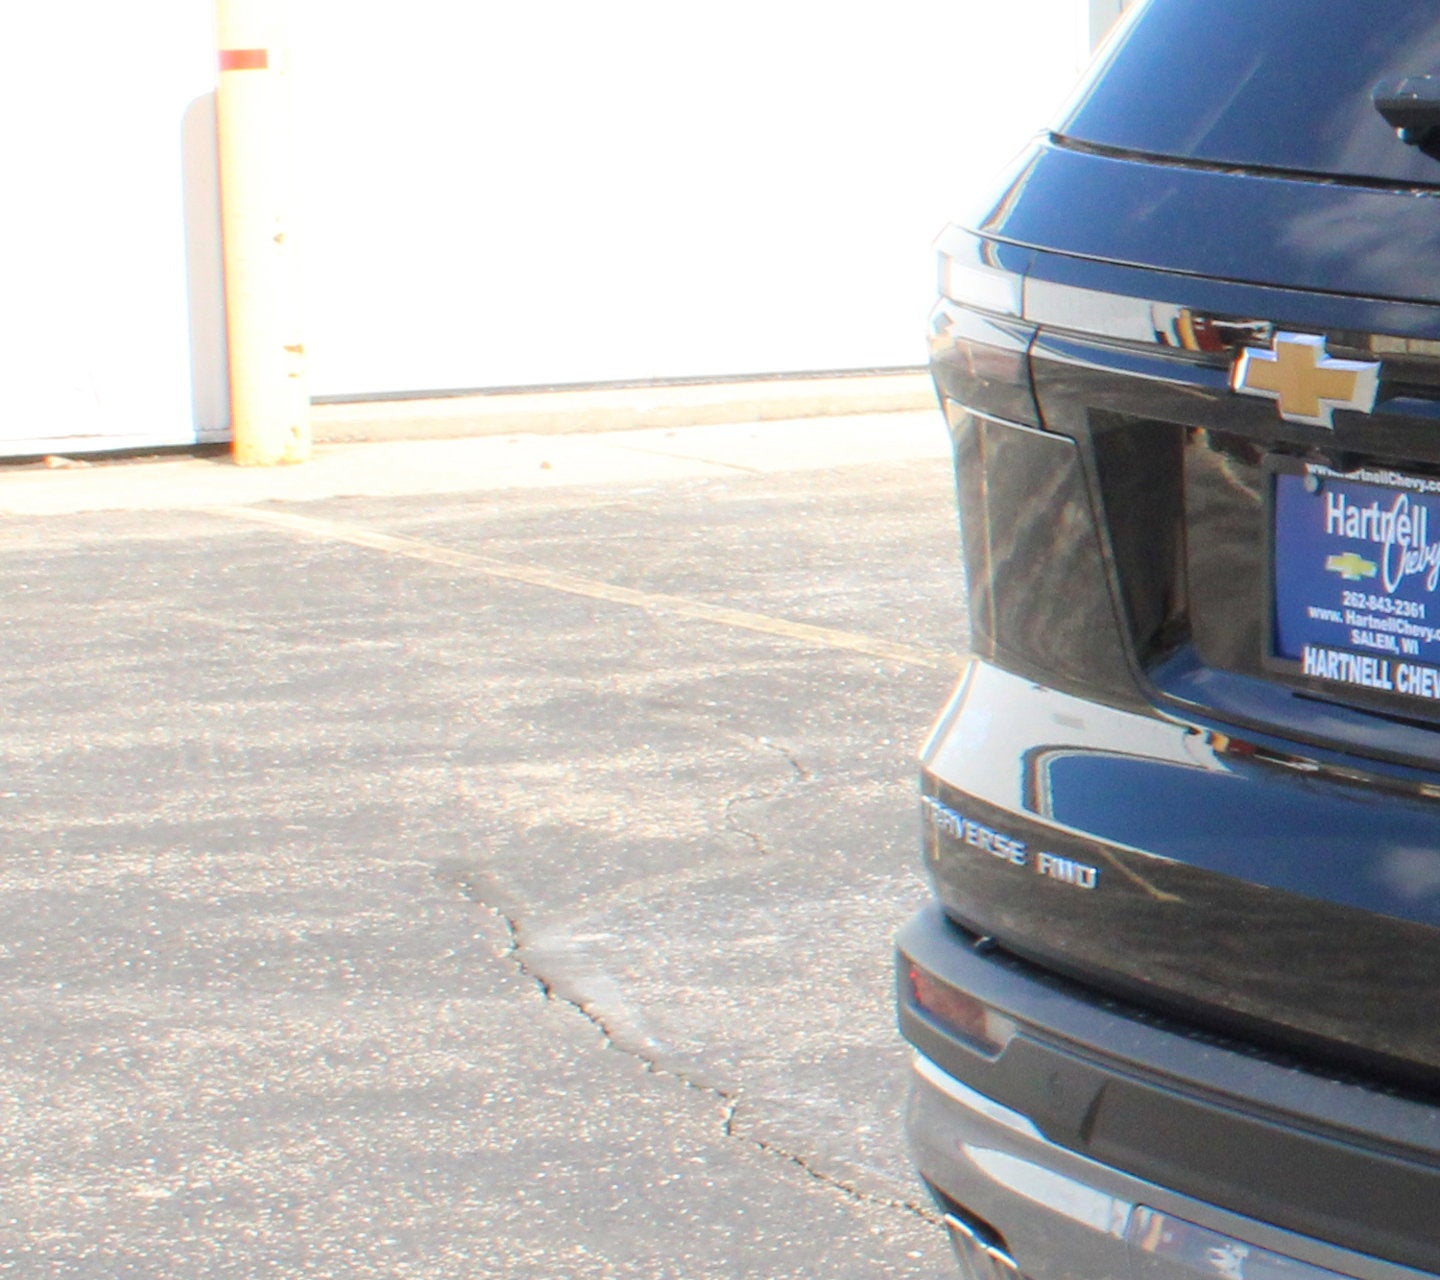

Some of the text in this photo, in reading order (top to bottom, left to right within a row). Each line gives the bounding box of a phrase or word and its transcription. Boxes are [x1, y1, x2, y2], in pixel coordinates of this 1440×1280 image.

[1325, 492, 1428, 546] Hartnell
[1307, 606, 1344, 624] www.
[1342, 591, 1426, 618] 262-843-2361
[1351, 628, 1420, 655] SALEM, WI
[1303, 645, 1394, 690] HARTNELL
[1037, 851, 1098, 890] AWD
